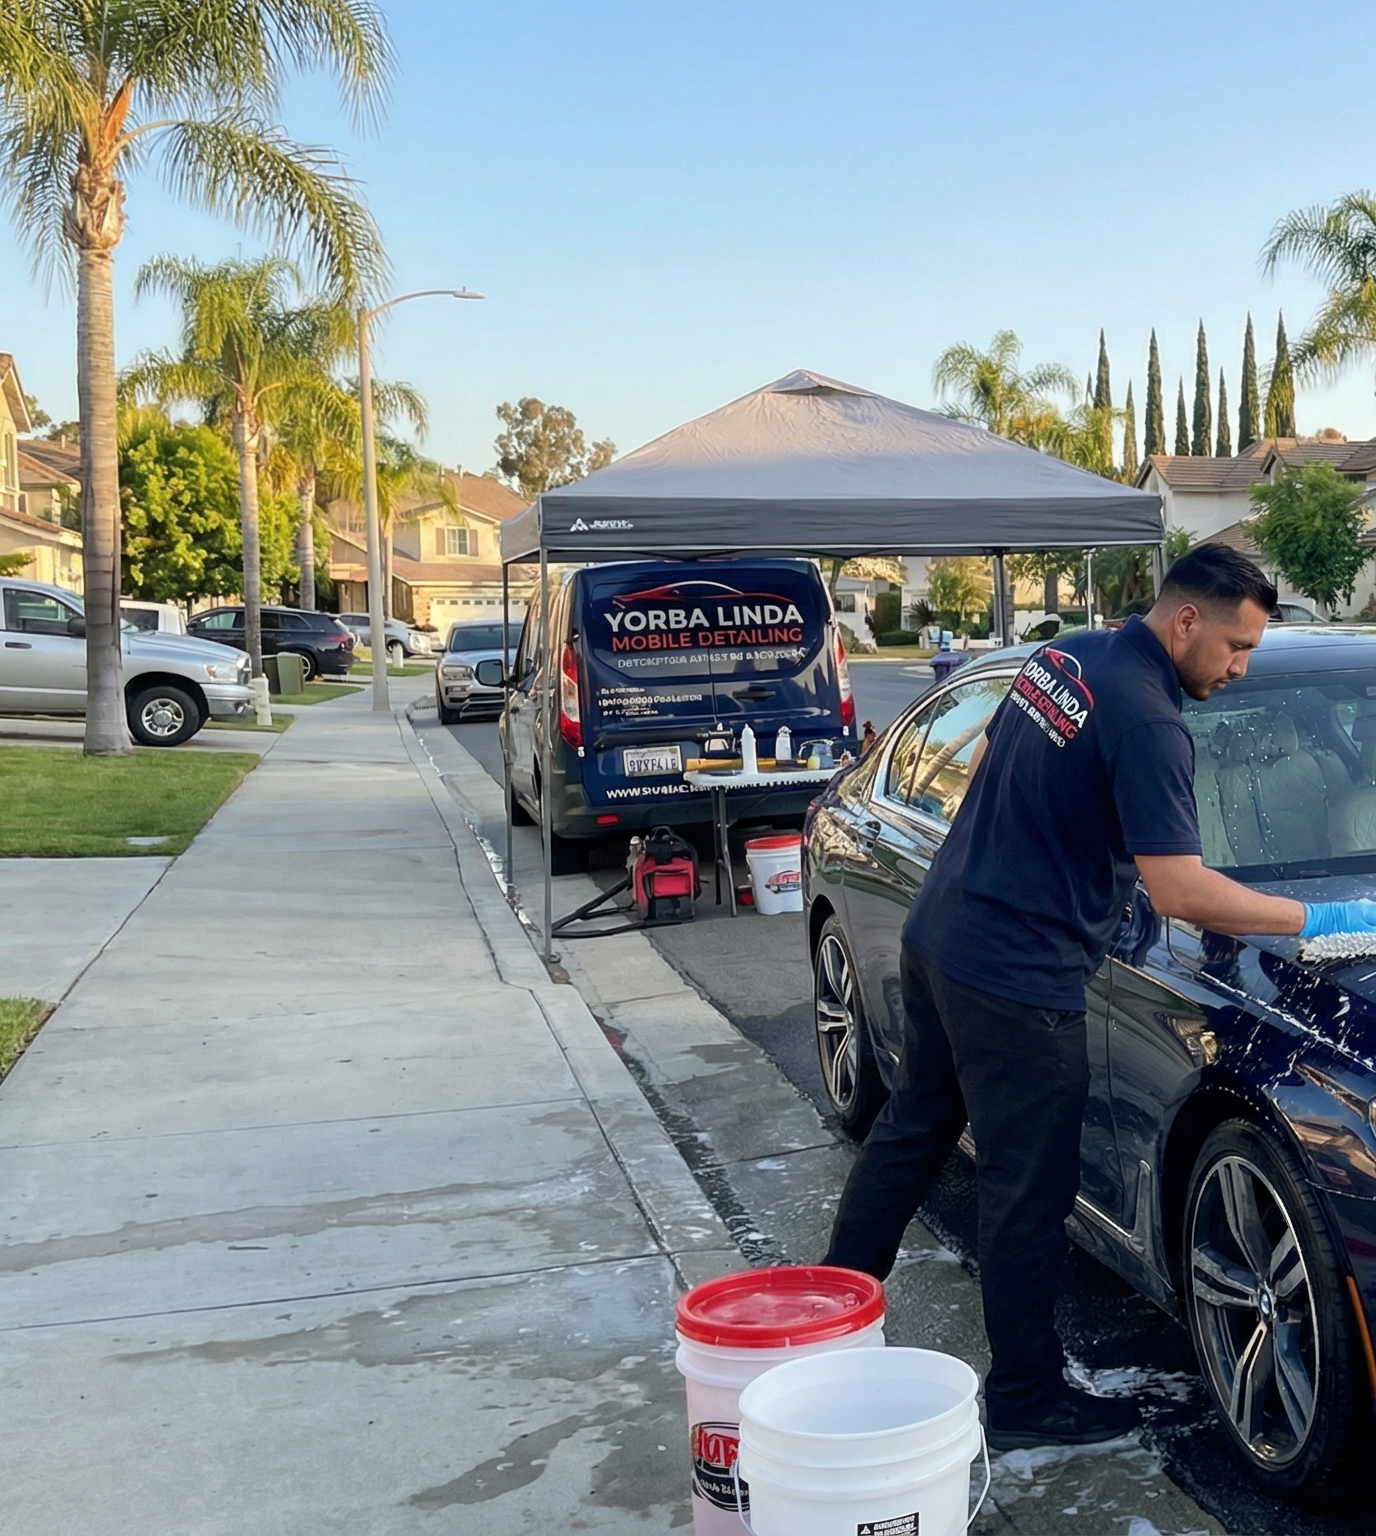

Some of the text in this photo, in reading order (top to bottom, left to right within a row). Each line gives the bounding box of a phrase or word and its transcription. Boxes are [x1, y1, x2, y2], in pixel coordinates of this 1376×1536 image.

[603, 604, 805, 633] YORBA LINDA
[612, 628, 803, 652] MOBILE DETAILING
